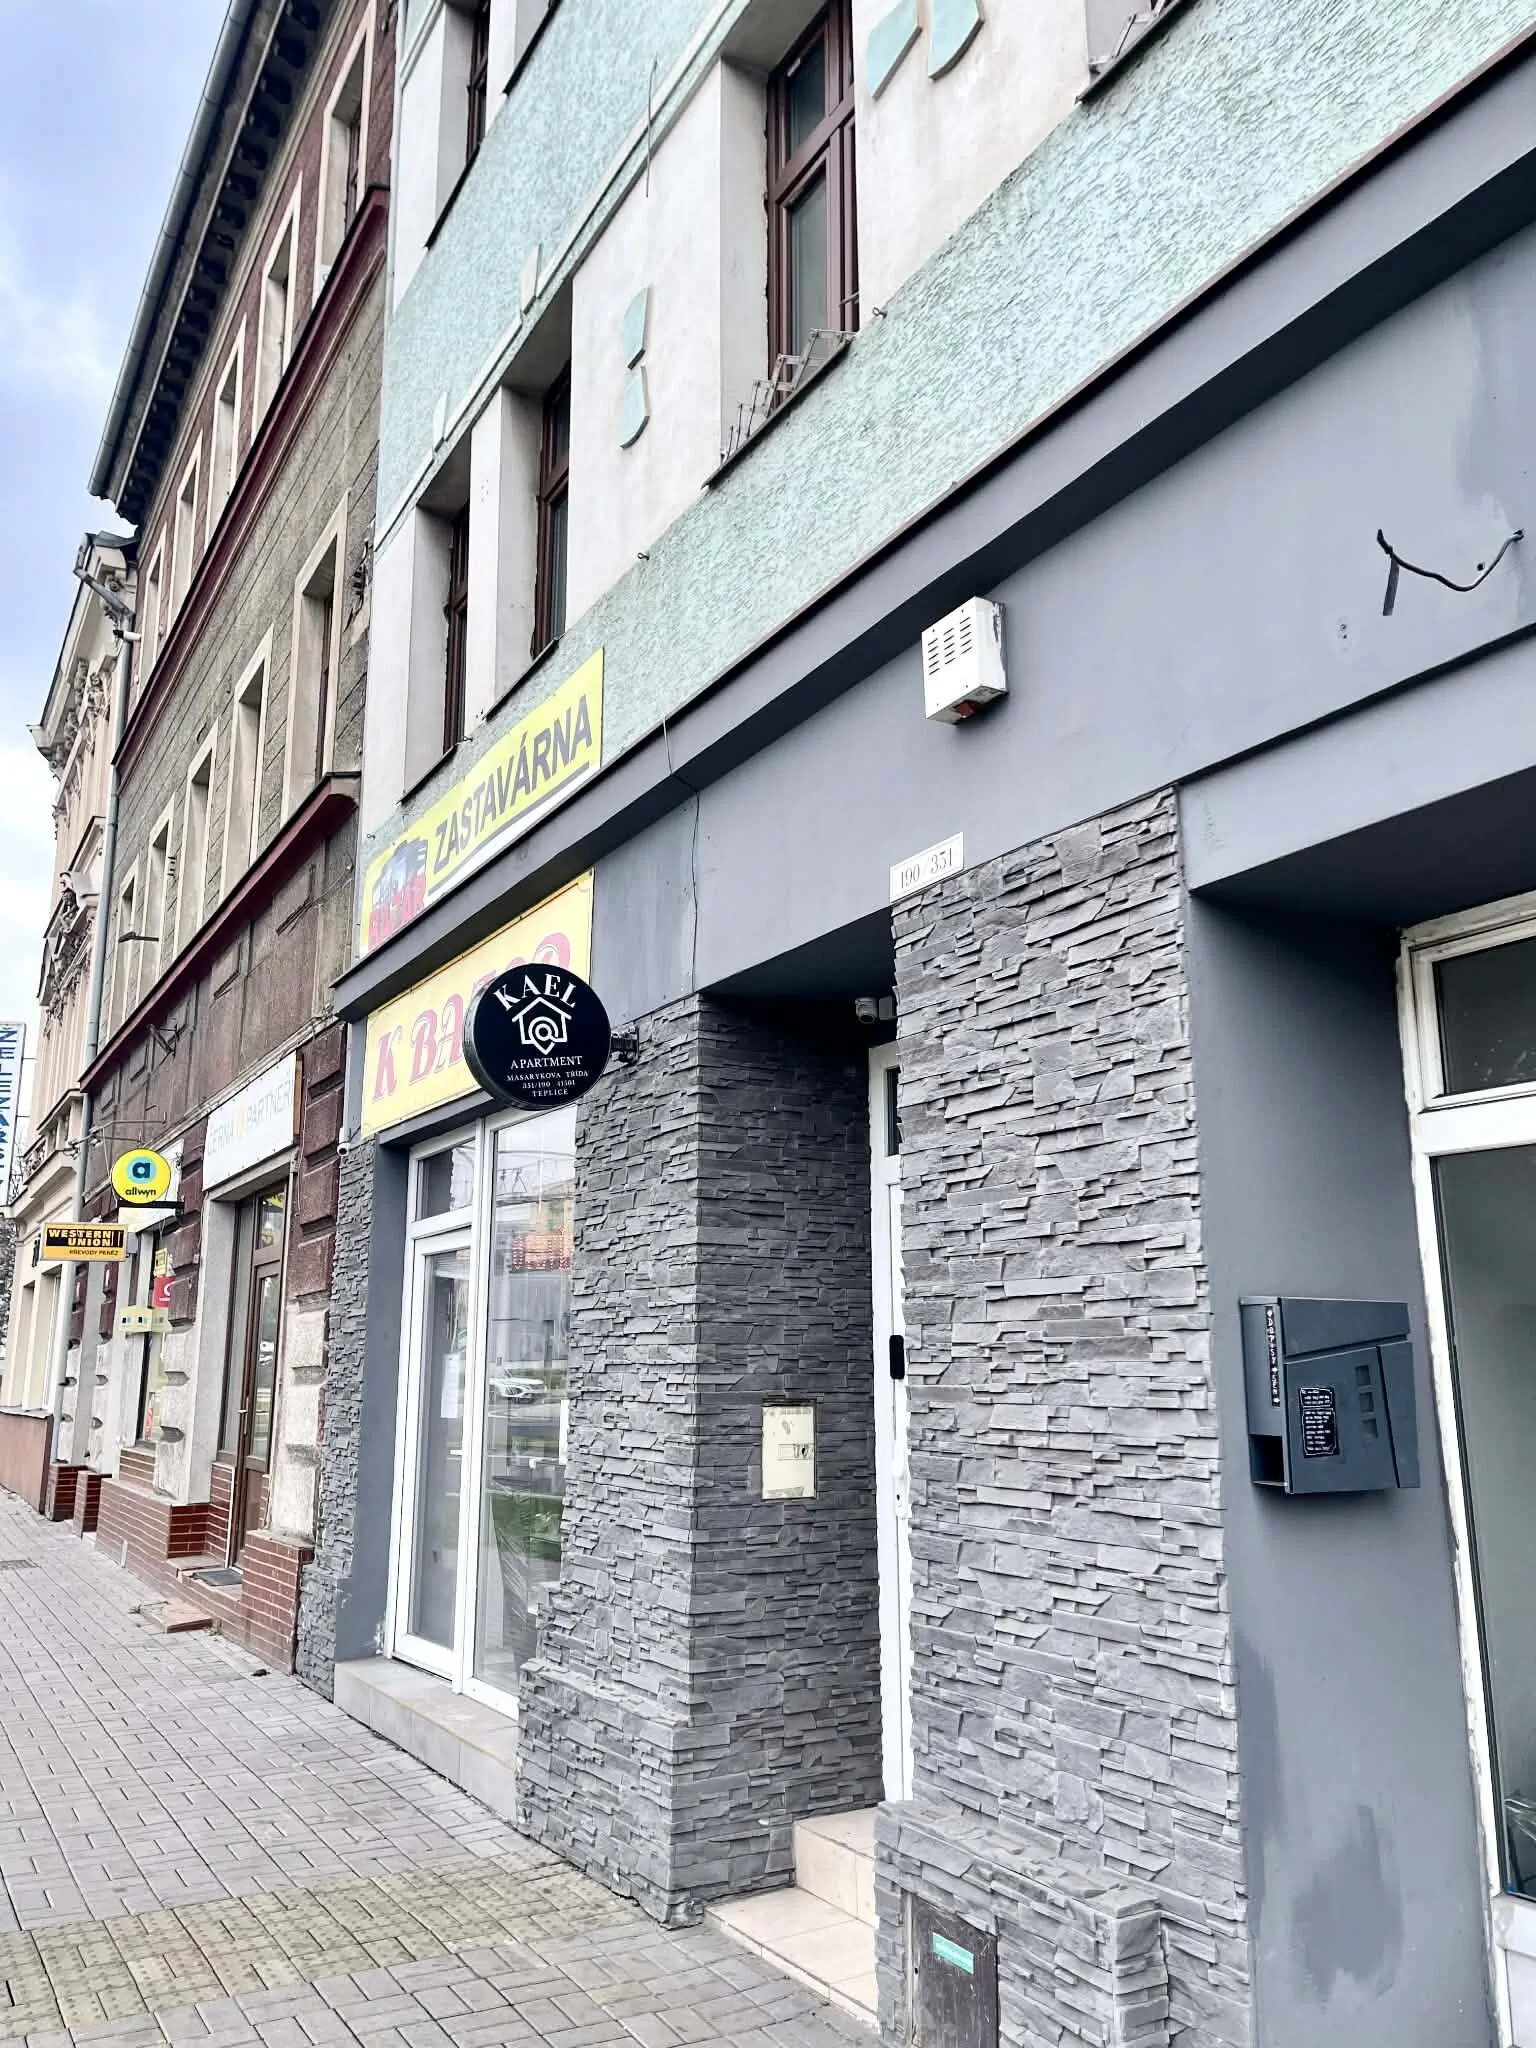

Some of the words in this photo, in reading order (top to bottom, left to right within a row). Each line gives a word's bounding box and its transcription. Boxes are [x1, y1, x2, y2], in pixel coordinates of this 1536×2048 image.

[433, 694, 593, 876] ZASTAVÁRNA
[494, 973, 577, 1012] KAEL
[373, 1025, 403, 1103] K
[510, 1055, 583, 1069] APARTMENT
[506, 1072, 561, 1081] MASARYKOVA
[532, 1088, 569, 1097] TEPLICE
[125, 1187, 156, 1198] allwyn
[48, 1229, 111, 1238] WESTERN
[67, 1237, 111, 1246] UNION
